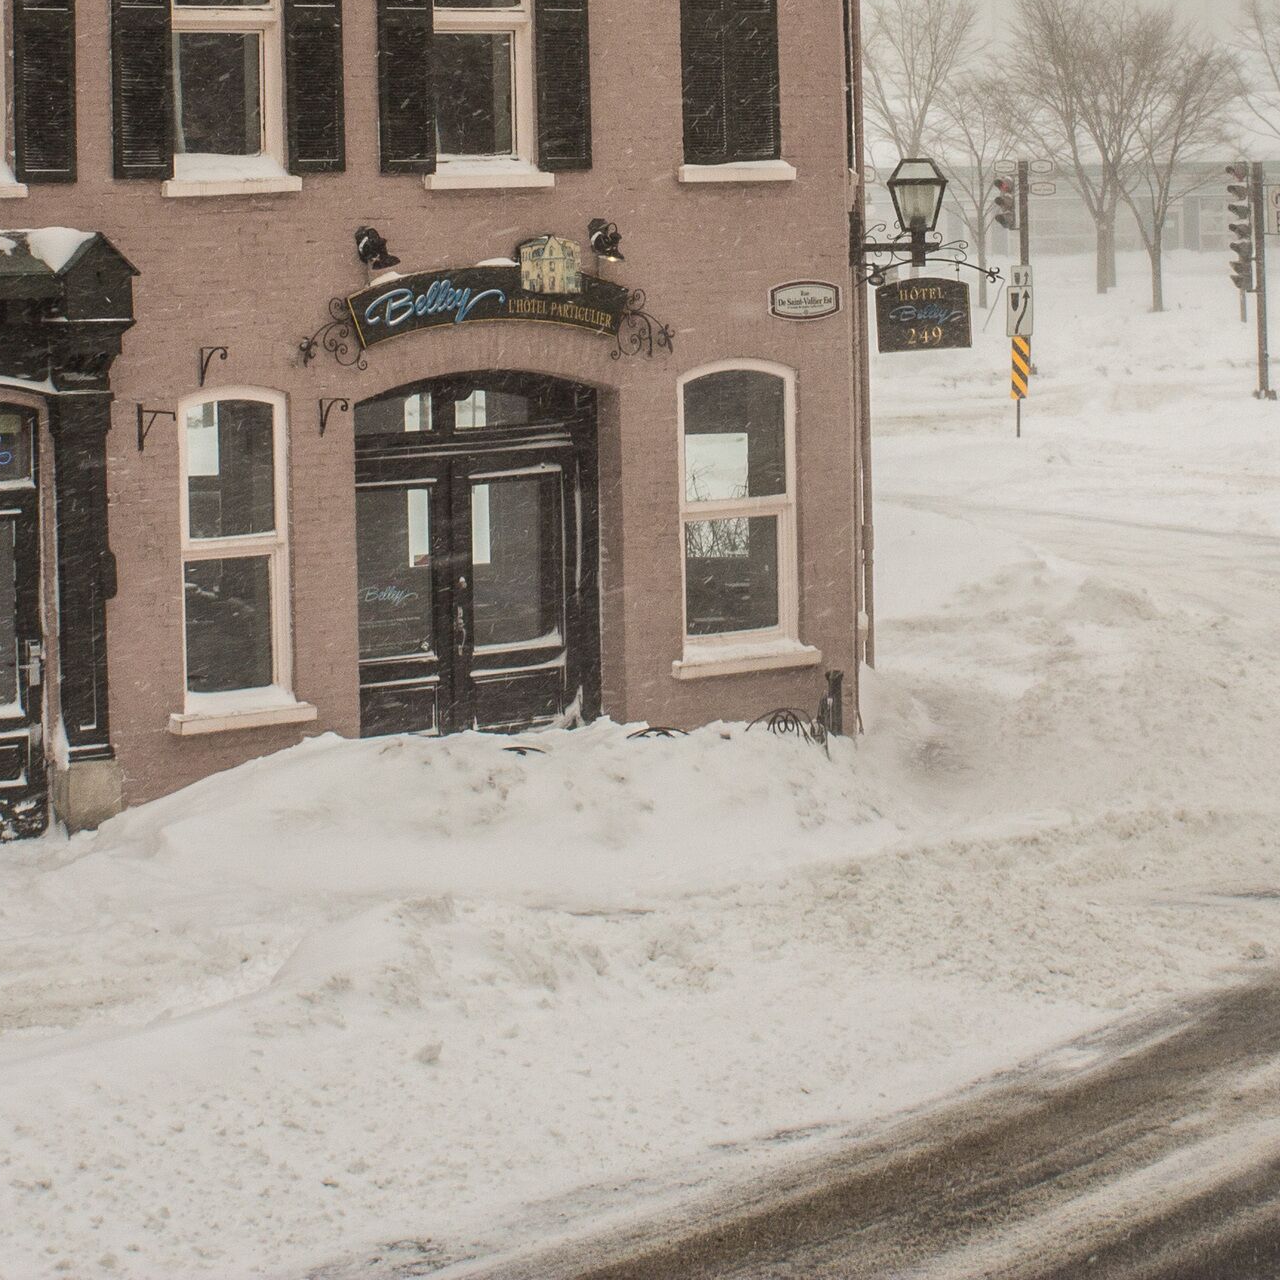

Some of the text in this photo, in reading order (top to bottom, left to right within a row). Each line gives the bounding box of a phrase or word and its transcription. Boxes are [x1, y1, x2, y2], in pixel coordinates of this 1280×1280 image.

[364, 279, 506, 325] Belley
[899, 286, 945, 301] HÔTEL
[550, 302, 613, 328] PARTICULIER
[907, 325, 942, 345] 249
